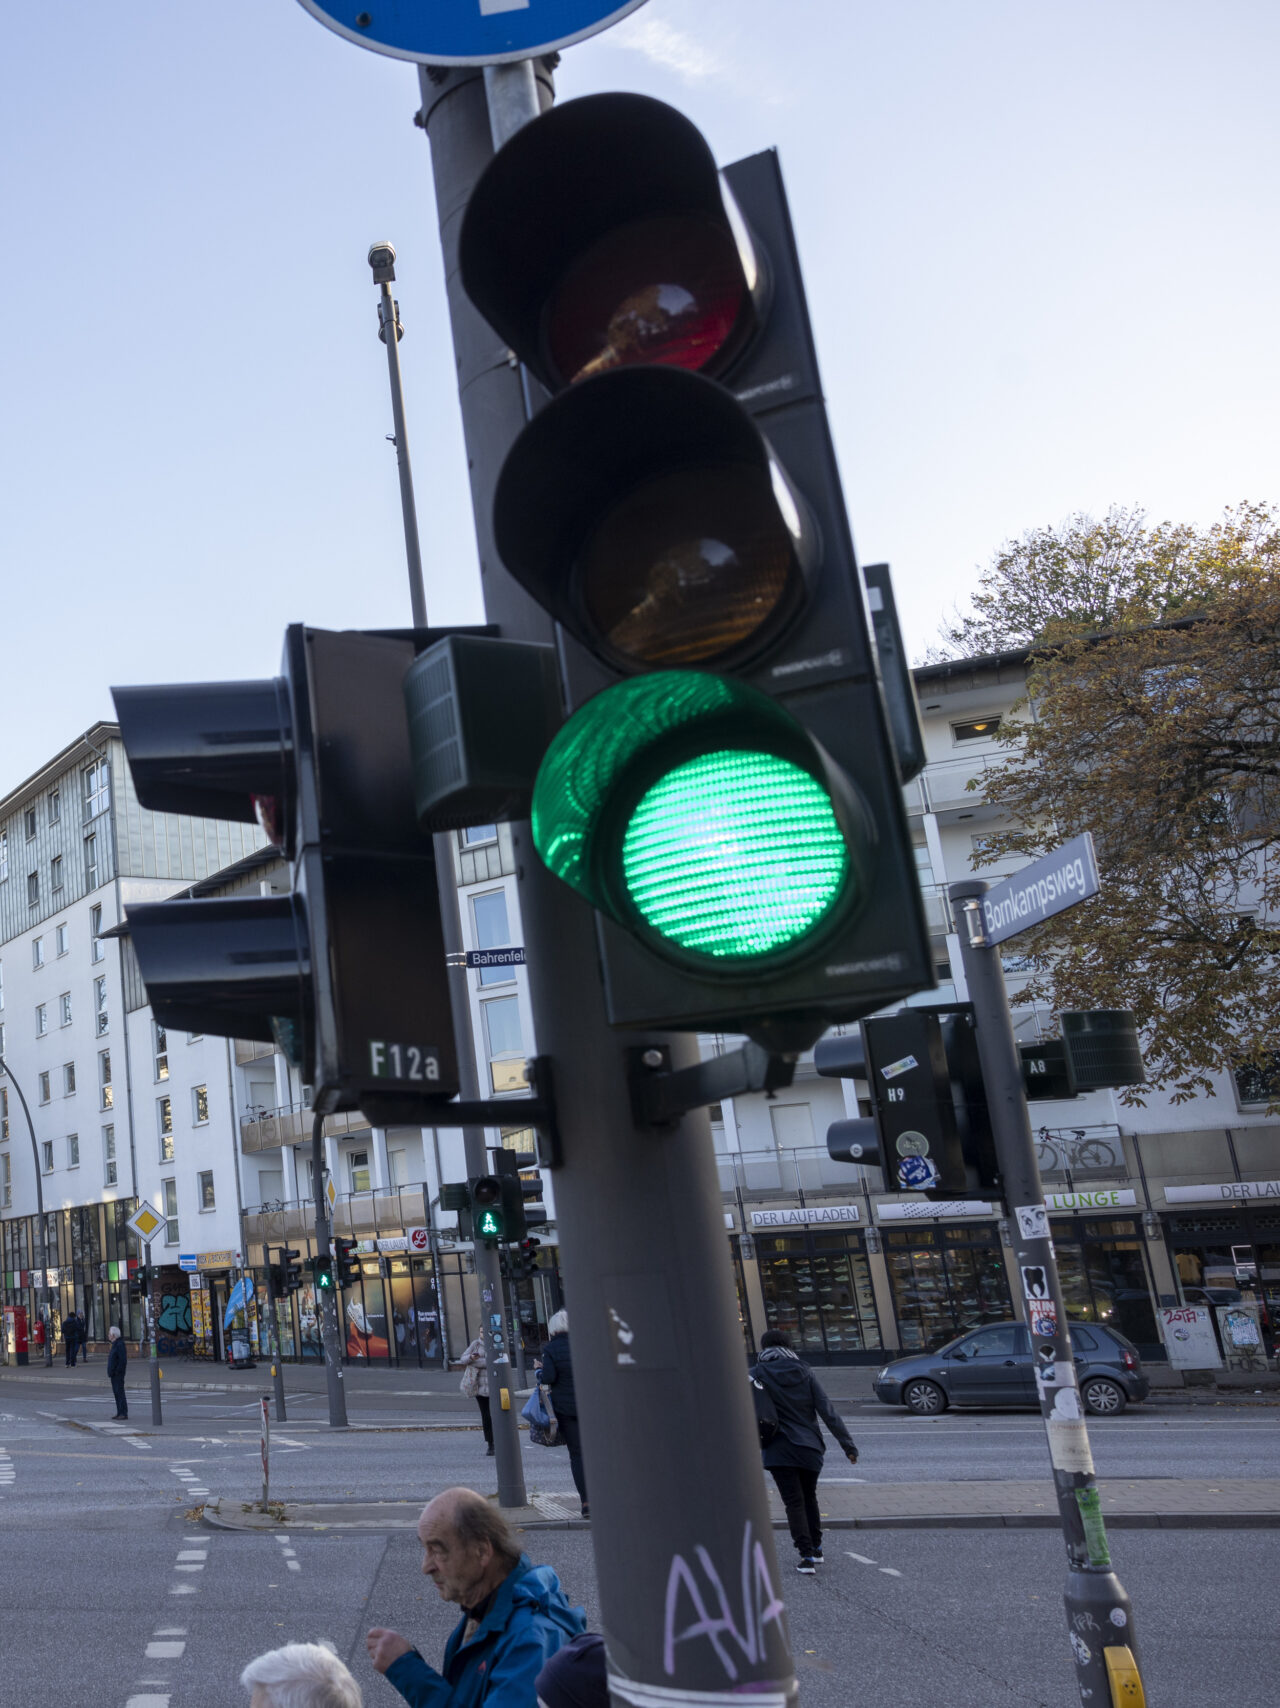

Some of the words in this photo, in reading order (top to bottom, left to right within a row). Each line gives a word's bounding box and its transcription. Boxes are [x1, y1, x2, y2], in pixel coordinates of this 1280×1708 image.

[983, 857, 1086, 934] Bornkampsweg
[1030, 1060, 1046, 1074] A8
[887, 1087, 905, 1103] H9
[1221, 1184, 1252, 1199] DER
[1052, 1191, 1121, 1209] LUNGE
[753, 1211, 779, 1226] DER
[781, 1207, 858, 1224] LAUFLADEN
[1029, 1300, 1056, 1311] RUN
